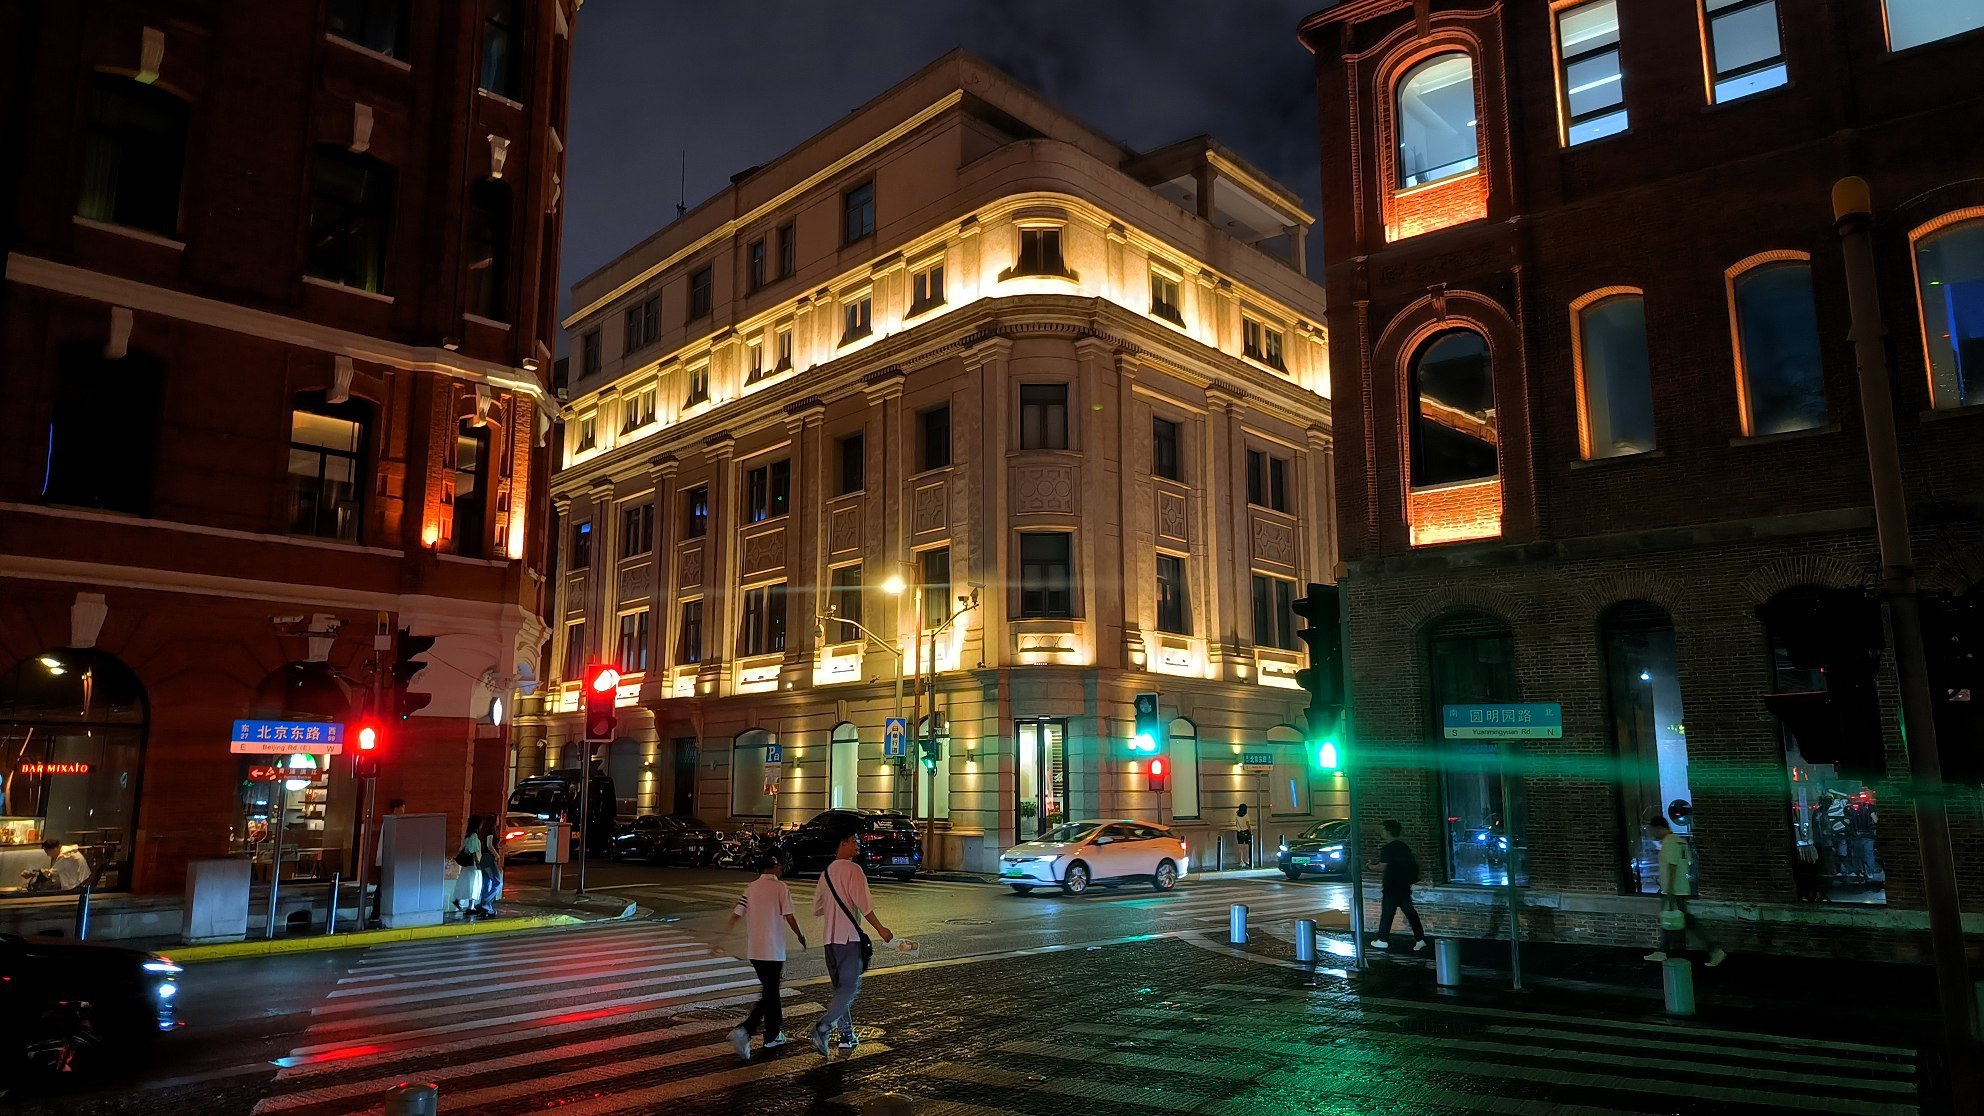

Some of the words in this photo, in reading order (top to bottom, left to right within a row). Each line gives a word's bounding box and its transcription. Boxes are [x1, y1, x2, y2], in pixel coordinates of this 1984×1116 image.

[1449, 709, 1458, 718] 南
[1470, 709, 1532, 723] 圆明园路
[1545, 708, 1554, 717] 北
[241, 724, 249, 732] 东
[257, 725, 320, 740] 北京东路
[328, 727, 336, 735] 西
[1452, 729, 1458, 737] S
[22, 764, 43, 773] BAR
